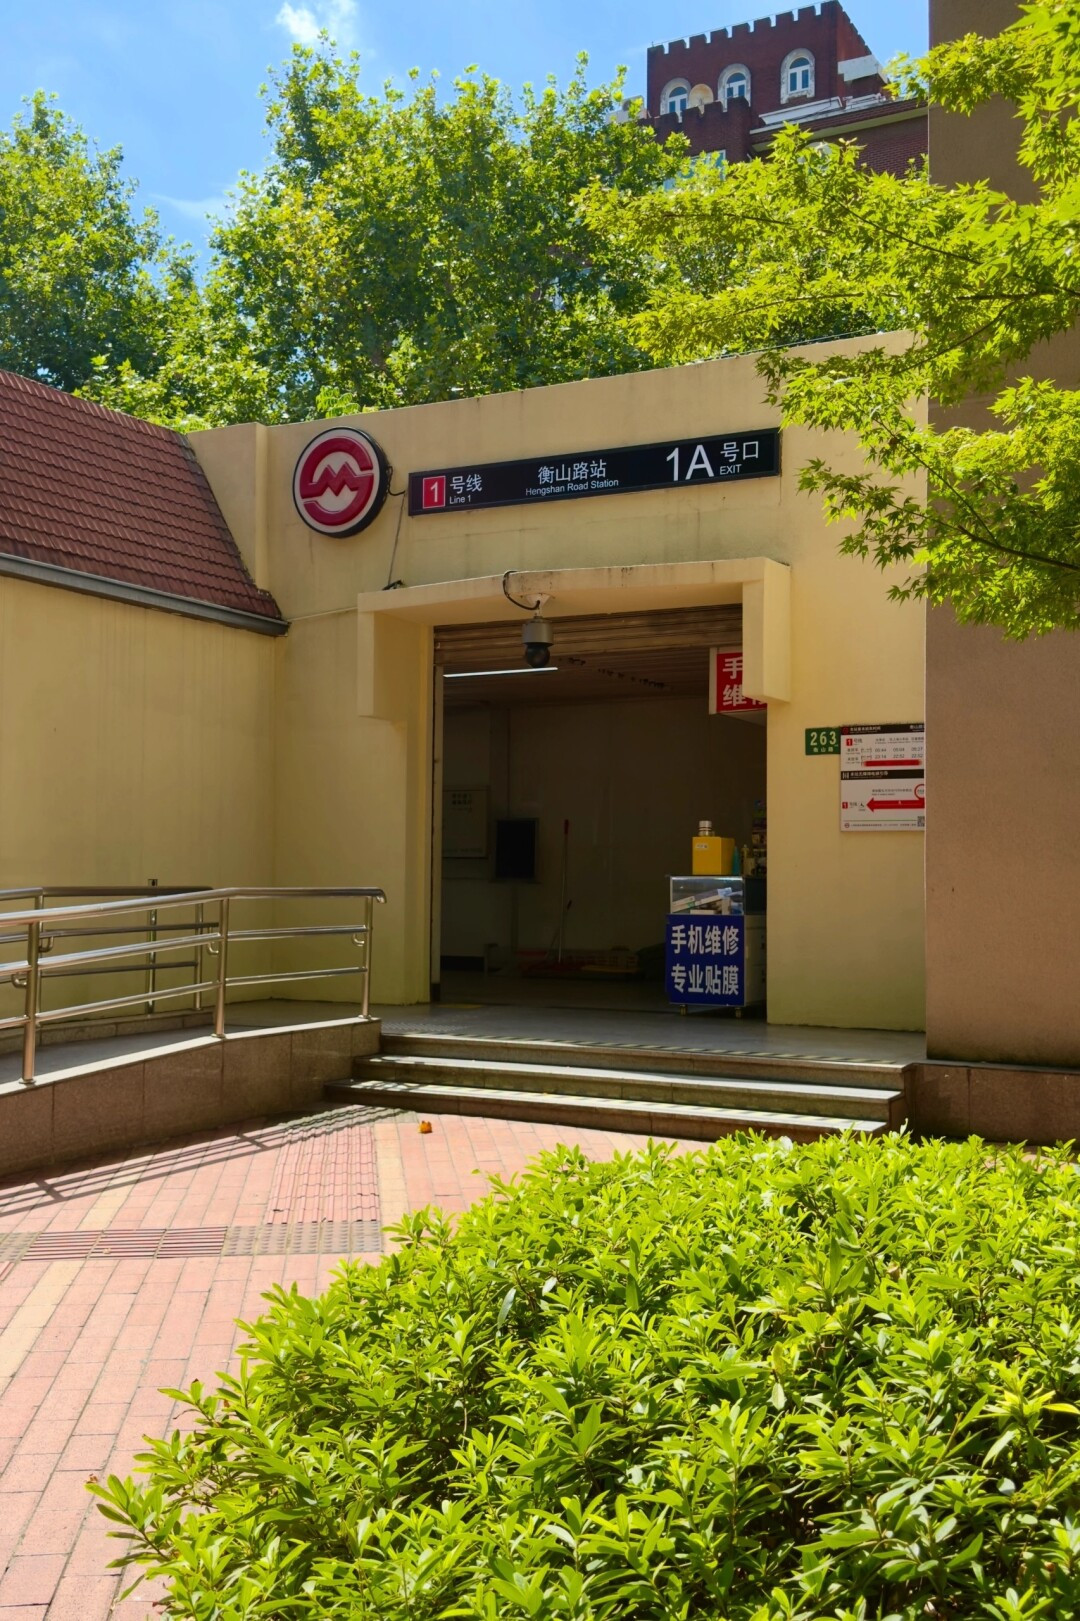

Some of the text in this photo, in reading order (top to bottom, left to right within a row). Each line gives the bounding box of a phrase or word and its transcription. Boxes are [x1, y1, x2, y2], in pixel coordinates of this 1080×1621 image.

[720, 441, 759, 462] 号口
[537, 459, 607, 485] 衡山路站
[666, 444, 715, 481] 1A
[719, 464, 742, 475] EXIT
[525, 479, 619, 496] Hengshan Road Station
[449, 496, 465, 504] Line
[810, 731, 837, 746] 263
[671, 924, 739, 955] 手机维修
[671, 963, 739, 995] 专业贴膜
